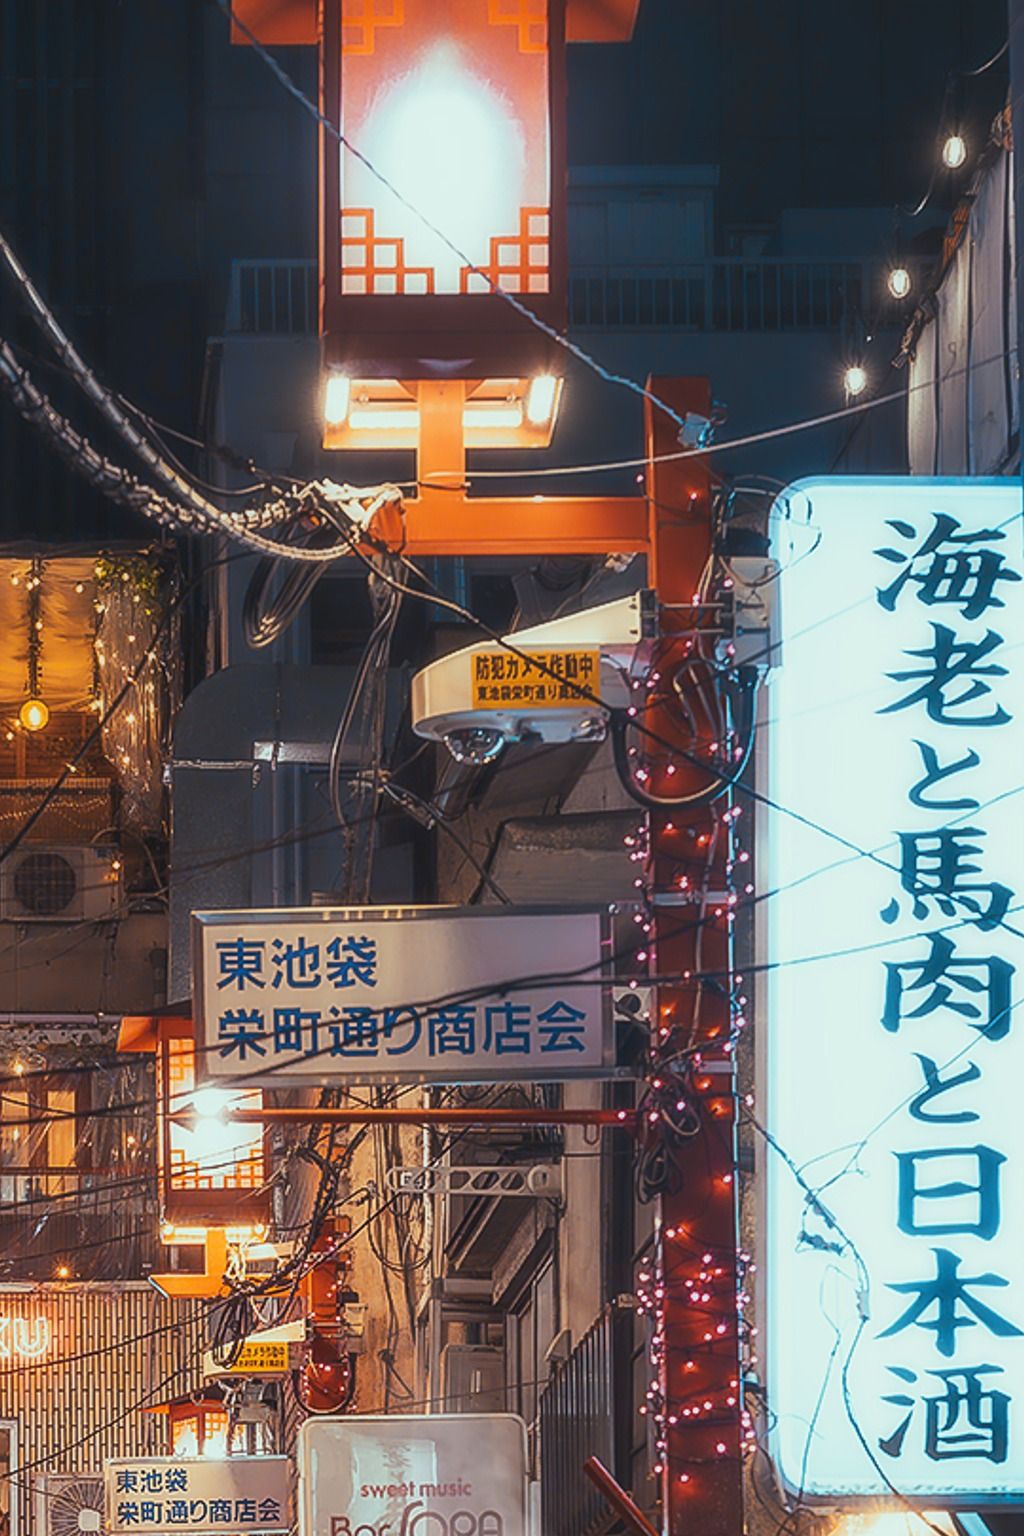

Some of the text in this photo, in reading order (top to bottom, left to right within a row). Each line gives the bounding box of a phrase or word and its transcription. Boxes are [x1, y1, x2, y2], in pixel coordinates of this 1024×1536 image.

[476, 654, 593, 680] 防犯カメラ作動中
[216, 936, 377, 991] 東池袋
[873, 511, 1023, 1465] 海老と馬肉と日本酒
[217, 1000, 587, 1060] 栄町通り商店会
[116, 1468, 187, 1493] 東池袋
[361, 1478, 472, 1498] sweet music
[117, 1498, 281, 1525] 栄町通り商店会
